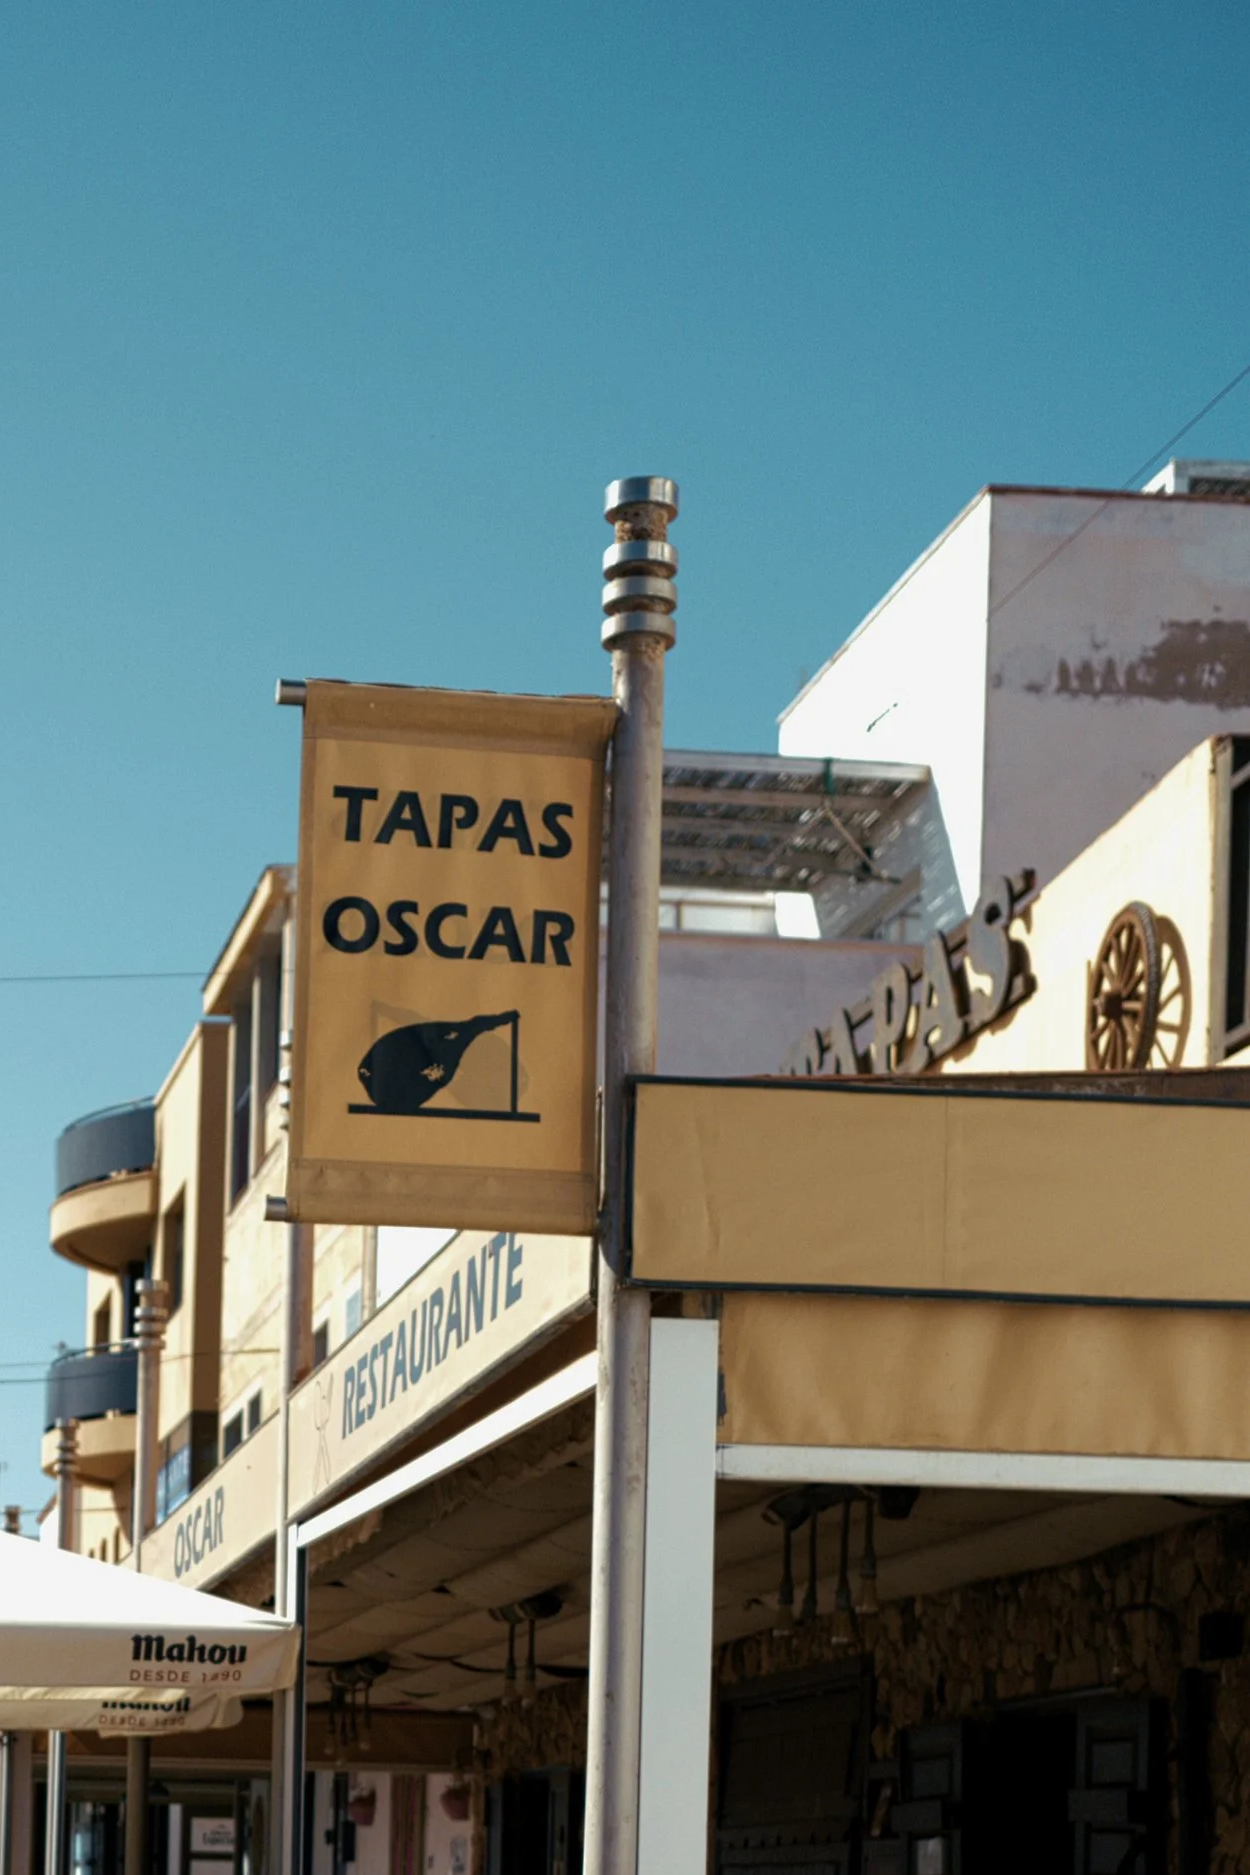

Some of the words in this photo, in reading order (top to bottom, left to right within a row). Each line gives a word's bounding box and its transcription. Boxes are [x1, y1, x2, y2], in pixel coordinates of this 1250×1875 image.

[333, 785, 574, 859] TAPAS
[322, 896, 575, 967] OSCAR
[342, 1231, 524, 1440] RESTAURANTE
[174, 1486, 225, 1578] OSCAR
[129, 1669, 190, 1683] DESDE
[131, 1633, 248, 1664] Mahou
